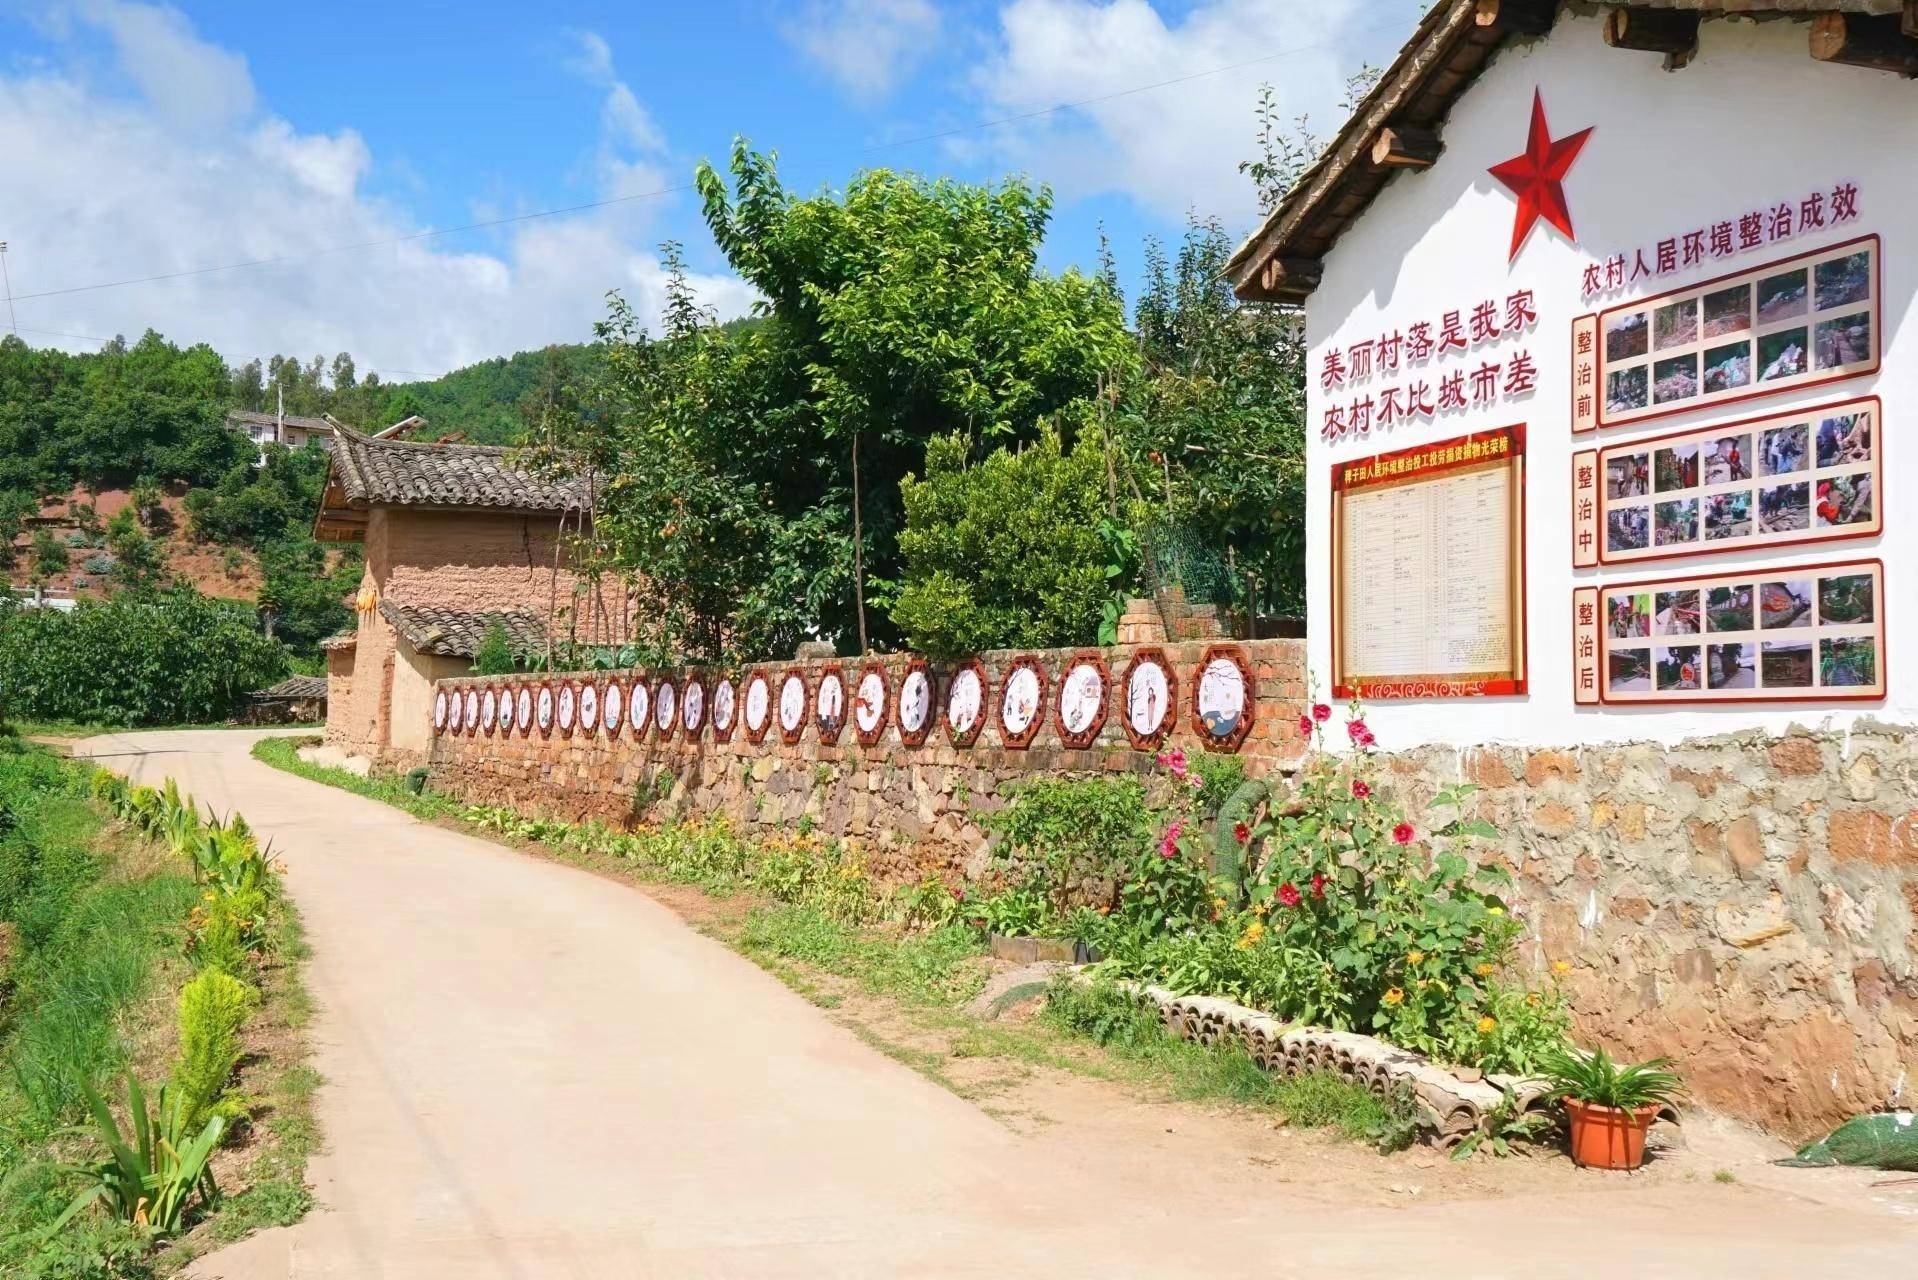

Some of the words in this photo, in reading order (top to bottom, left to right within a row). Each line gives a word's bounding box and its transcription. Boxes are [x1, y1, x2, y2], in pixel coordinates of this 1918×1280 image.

[1582, 183, 1858, 296] 农村人居环境整治成效
[1321, 289, 1537, 388] 美丽村落是我家
[1577, 330, 1592, 418] 整治前
[1321, 349, 1538, 440] 农村不比城市差
[1578, 466, 1593, 553] 整治中
[1579, 603, 1594, 689] 整治后
